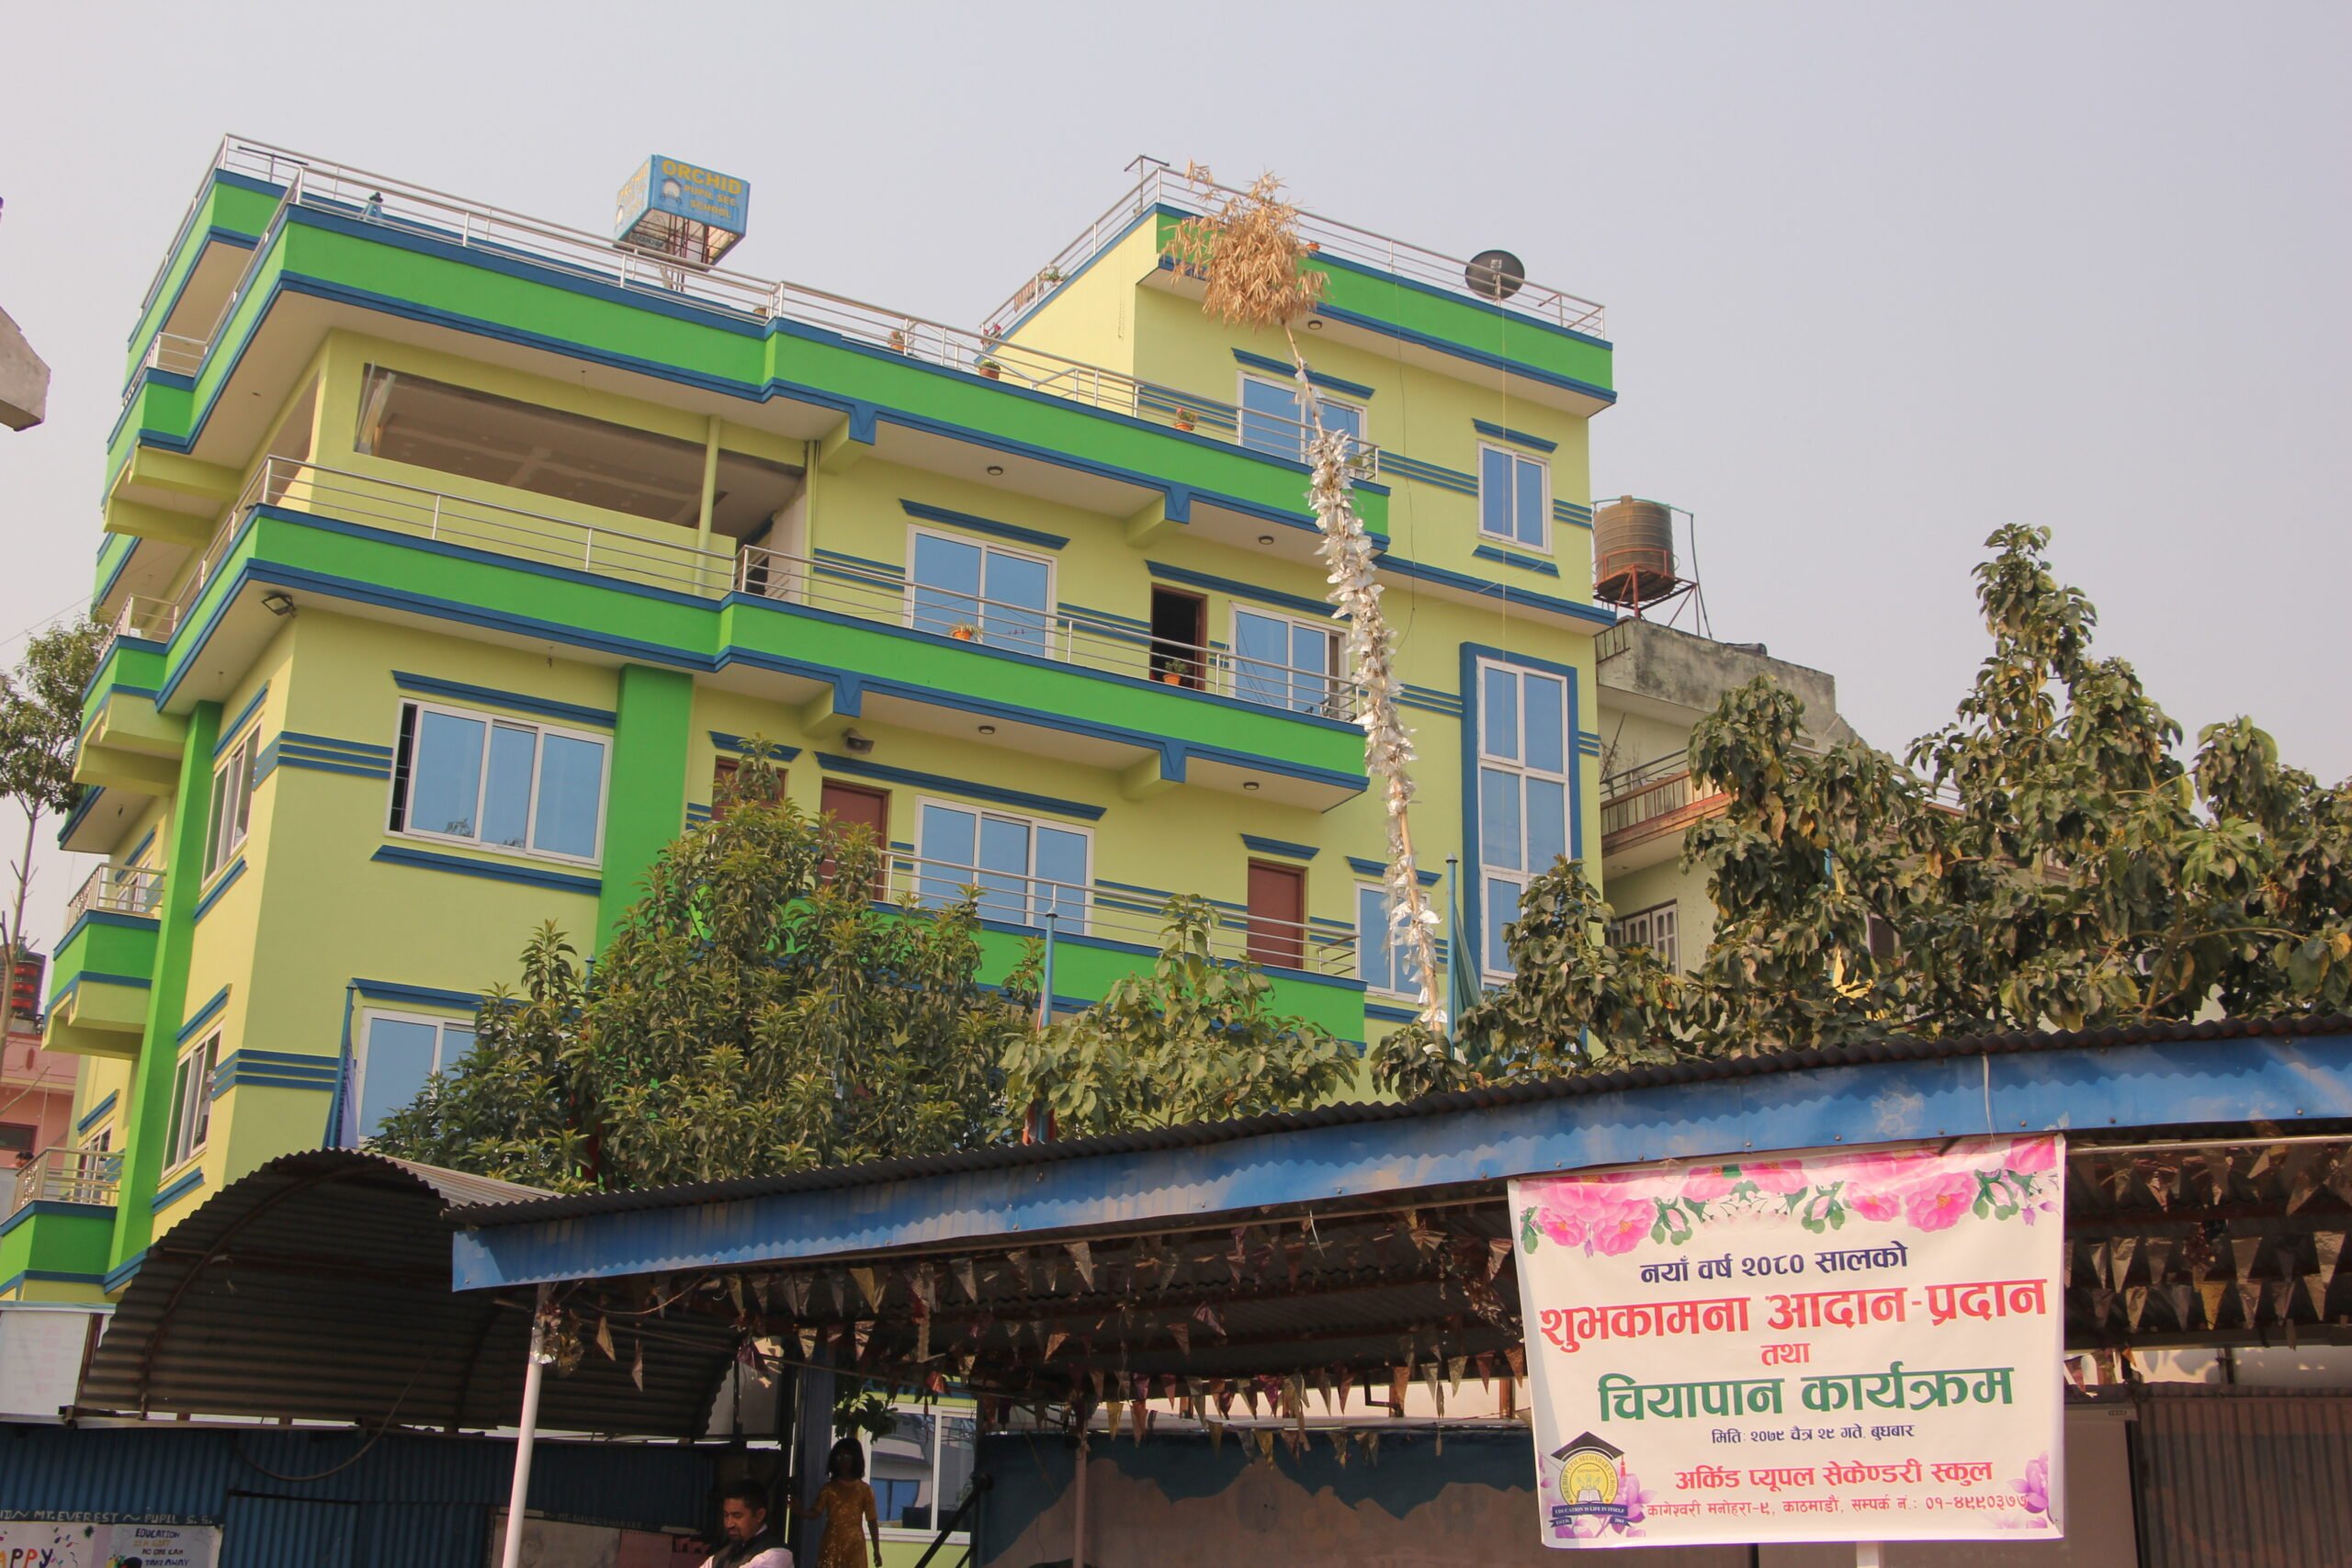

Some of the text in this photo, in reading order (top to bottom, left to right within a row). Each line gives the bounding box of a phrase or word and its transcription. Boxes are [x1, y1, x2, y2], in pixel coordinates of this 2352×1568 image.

[662, 159, 742, 195] ORCHID
[684, 184, 714, 200] PUPIL
[690, 199, 732, 219] SCHOOL
[1640, 1240, 1908, 1283] नयाँ वर्ष २०८० सालको
[1540, 1297, 1750, 1353] शुभकामना
[1760, 1342, 1810, 1367] तथा
[1598, 1360, 2015, 1422] चियापान कार्यक्रम
[1750, 1428, 1785, 1442] २०७९
[1790, 1426, 1814, 1440] चैत्र
[1817, 1427, 1835, 1439] २९
[1676, 1459, 1993, 1492] अर्किड प्यूपल सेकेण्डरी स्कुल
[1645, 1500, 1702, 1517] कागेश्वरी
[1851, 1494, 1891, 1513] सम्पर्क
[145, 1514, 177, 1524] PUPIL
[135, 1528, 180, 1539] EDUCATION
